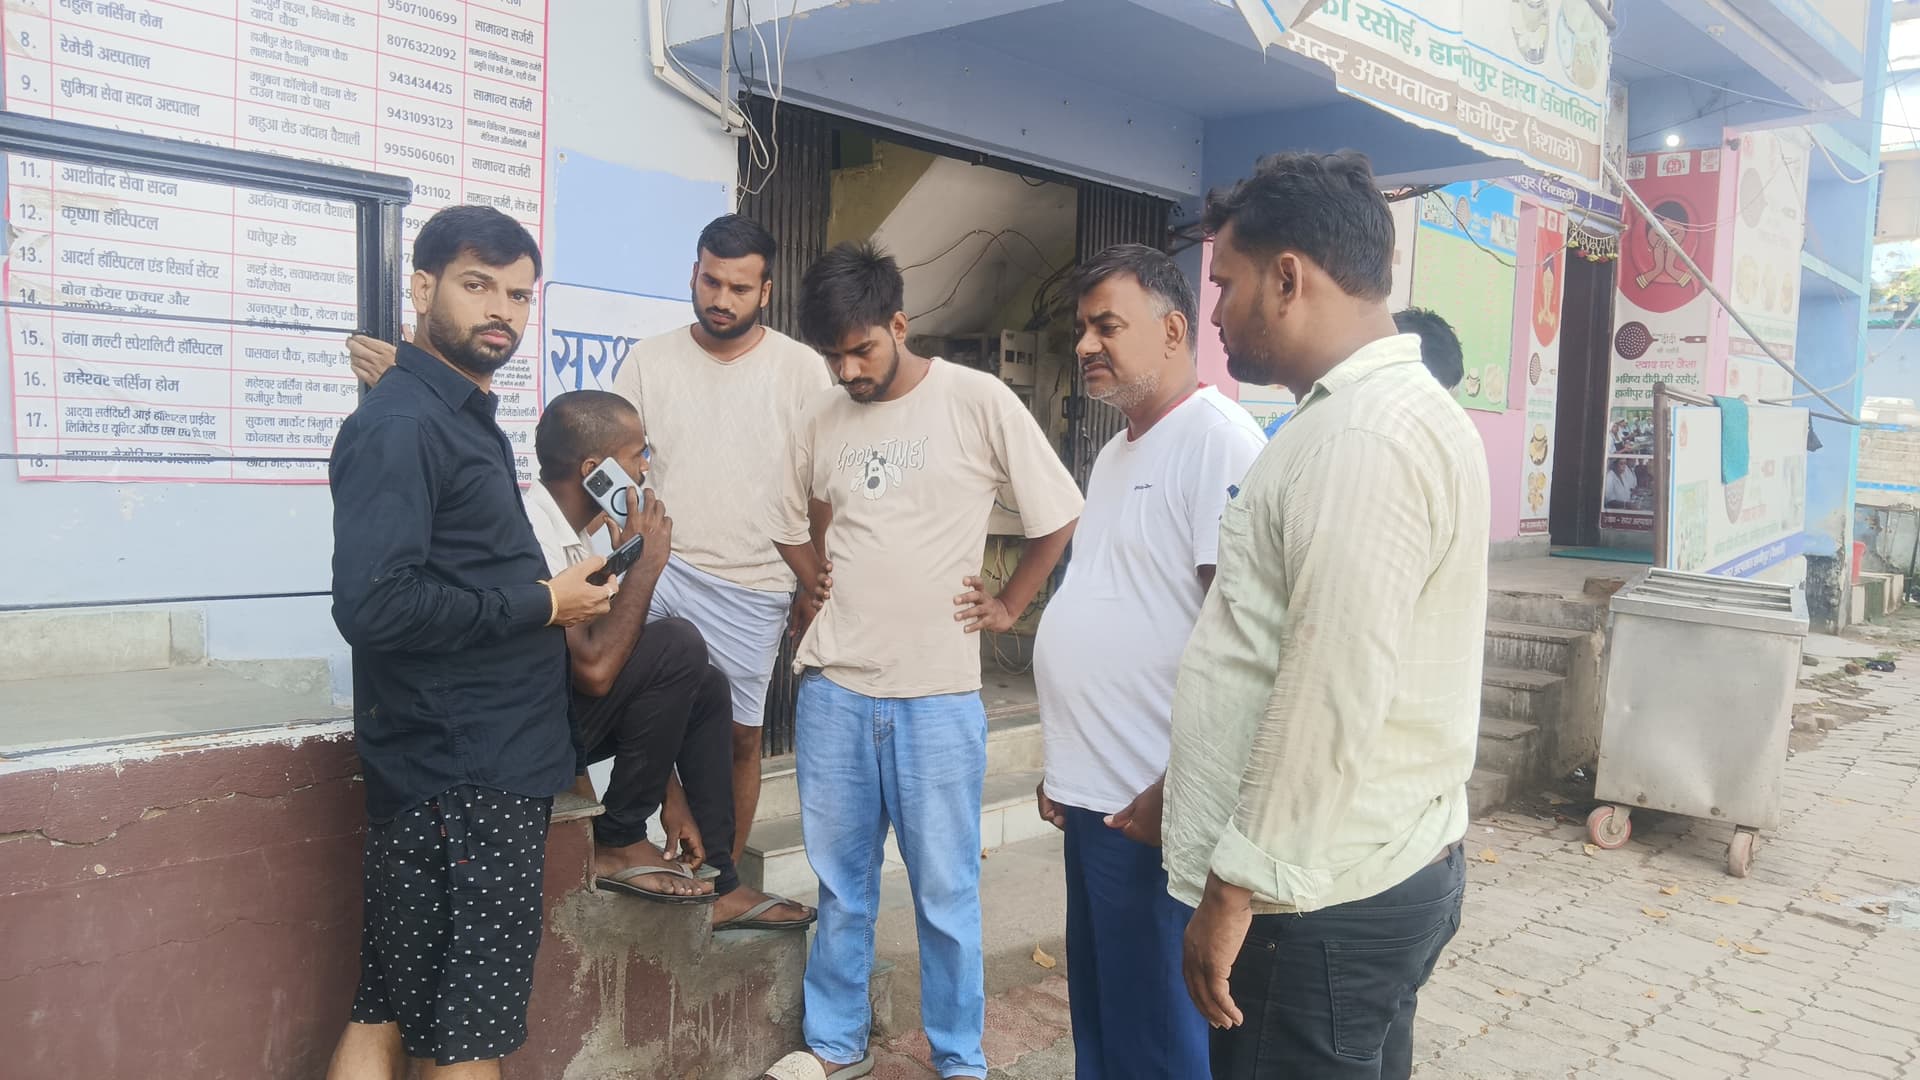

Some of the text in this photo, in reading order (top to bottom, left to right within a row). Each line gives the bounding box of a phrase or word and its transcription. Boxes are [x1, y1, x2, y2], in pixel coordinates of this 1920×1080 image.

[140, 10, 163, 30] होम
[475, 19, 534, 45] सामान्य सर्जरी
[20, 31, 36, 49] 8.
[60, 33, 150, 70] रेमेडी अस्पताल
[386, 34, 457, 61] 8076322092
[1355, 2, 1422, 57] रसोई,
[1502, 70, 1538, 104] द्वारा
[1540, 87, 1598, 132] संचालित
[21, 74, 38, 92] 9.
[388, 72, 453, 96] 943434425
[1287, 28, 1348, 74] सदर
[1352, 56, 1452, 112] अस्पताल
[1456, 94, 1518, 143] हाजीपुर
[60, 76, 200, 117] सुमित्रा सेवा सदन अस्पताल
[473, 88, 532, 112] सामान्य सर्जरी
[386, 106, 454, 130] 9431093123
[384, 142, 455, 166] 9955060601
[20, 161, 40, 179] 11.
[472, 157, 531, 179] सामान्य सर्जरी
[119, 170, 144, 192] सेवा
[148, 180, 178, 197] सदन
[19, 203, 42, 222] 12.
[61, 204, 159, 230] कृष्णा हॉस्पिटल
[19, 246, 42, 264] 13.
[61, 248, 94, 266] आदर्श
[98, 250, 144, 272] हॉस्पिटल
[196, 260, 220, 279] सेंटर
[61, 281, 86, 297] बोन
[168, 290, 190, 306] और
[20, 330, 44, 347] 15.
[62, 330, 88, 346] गंगा
[178, 338, 223, 356] हॉस्पिटल
[24, 372, 46, 387] 16.
[63, 368, 110, 386] महेश्वर
[155, 376, 180, 392] होम
[26, 412, 48, 428] 17.
